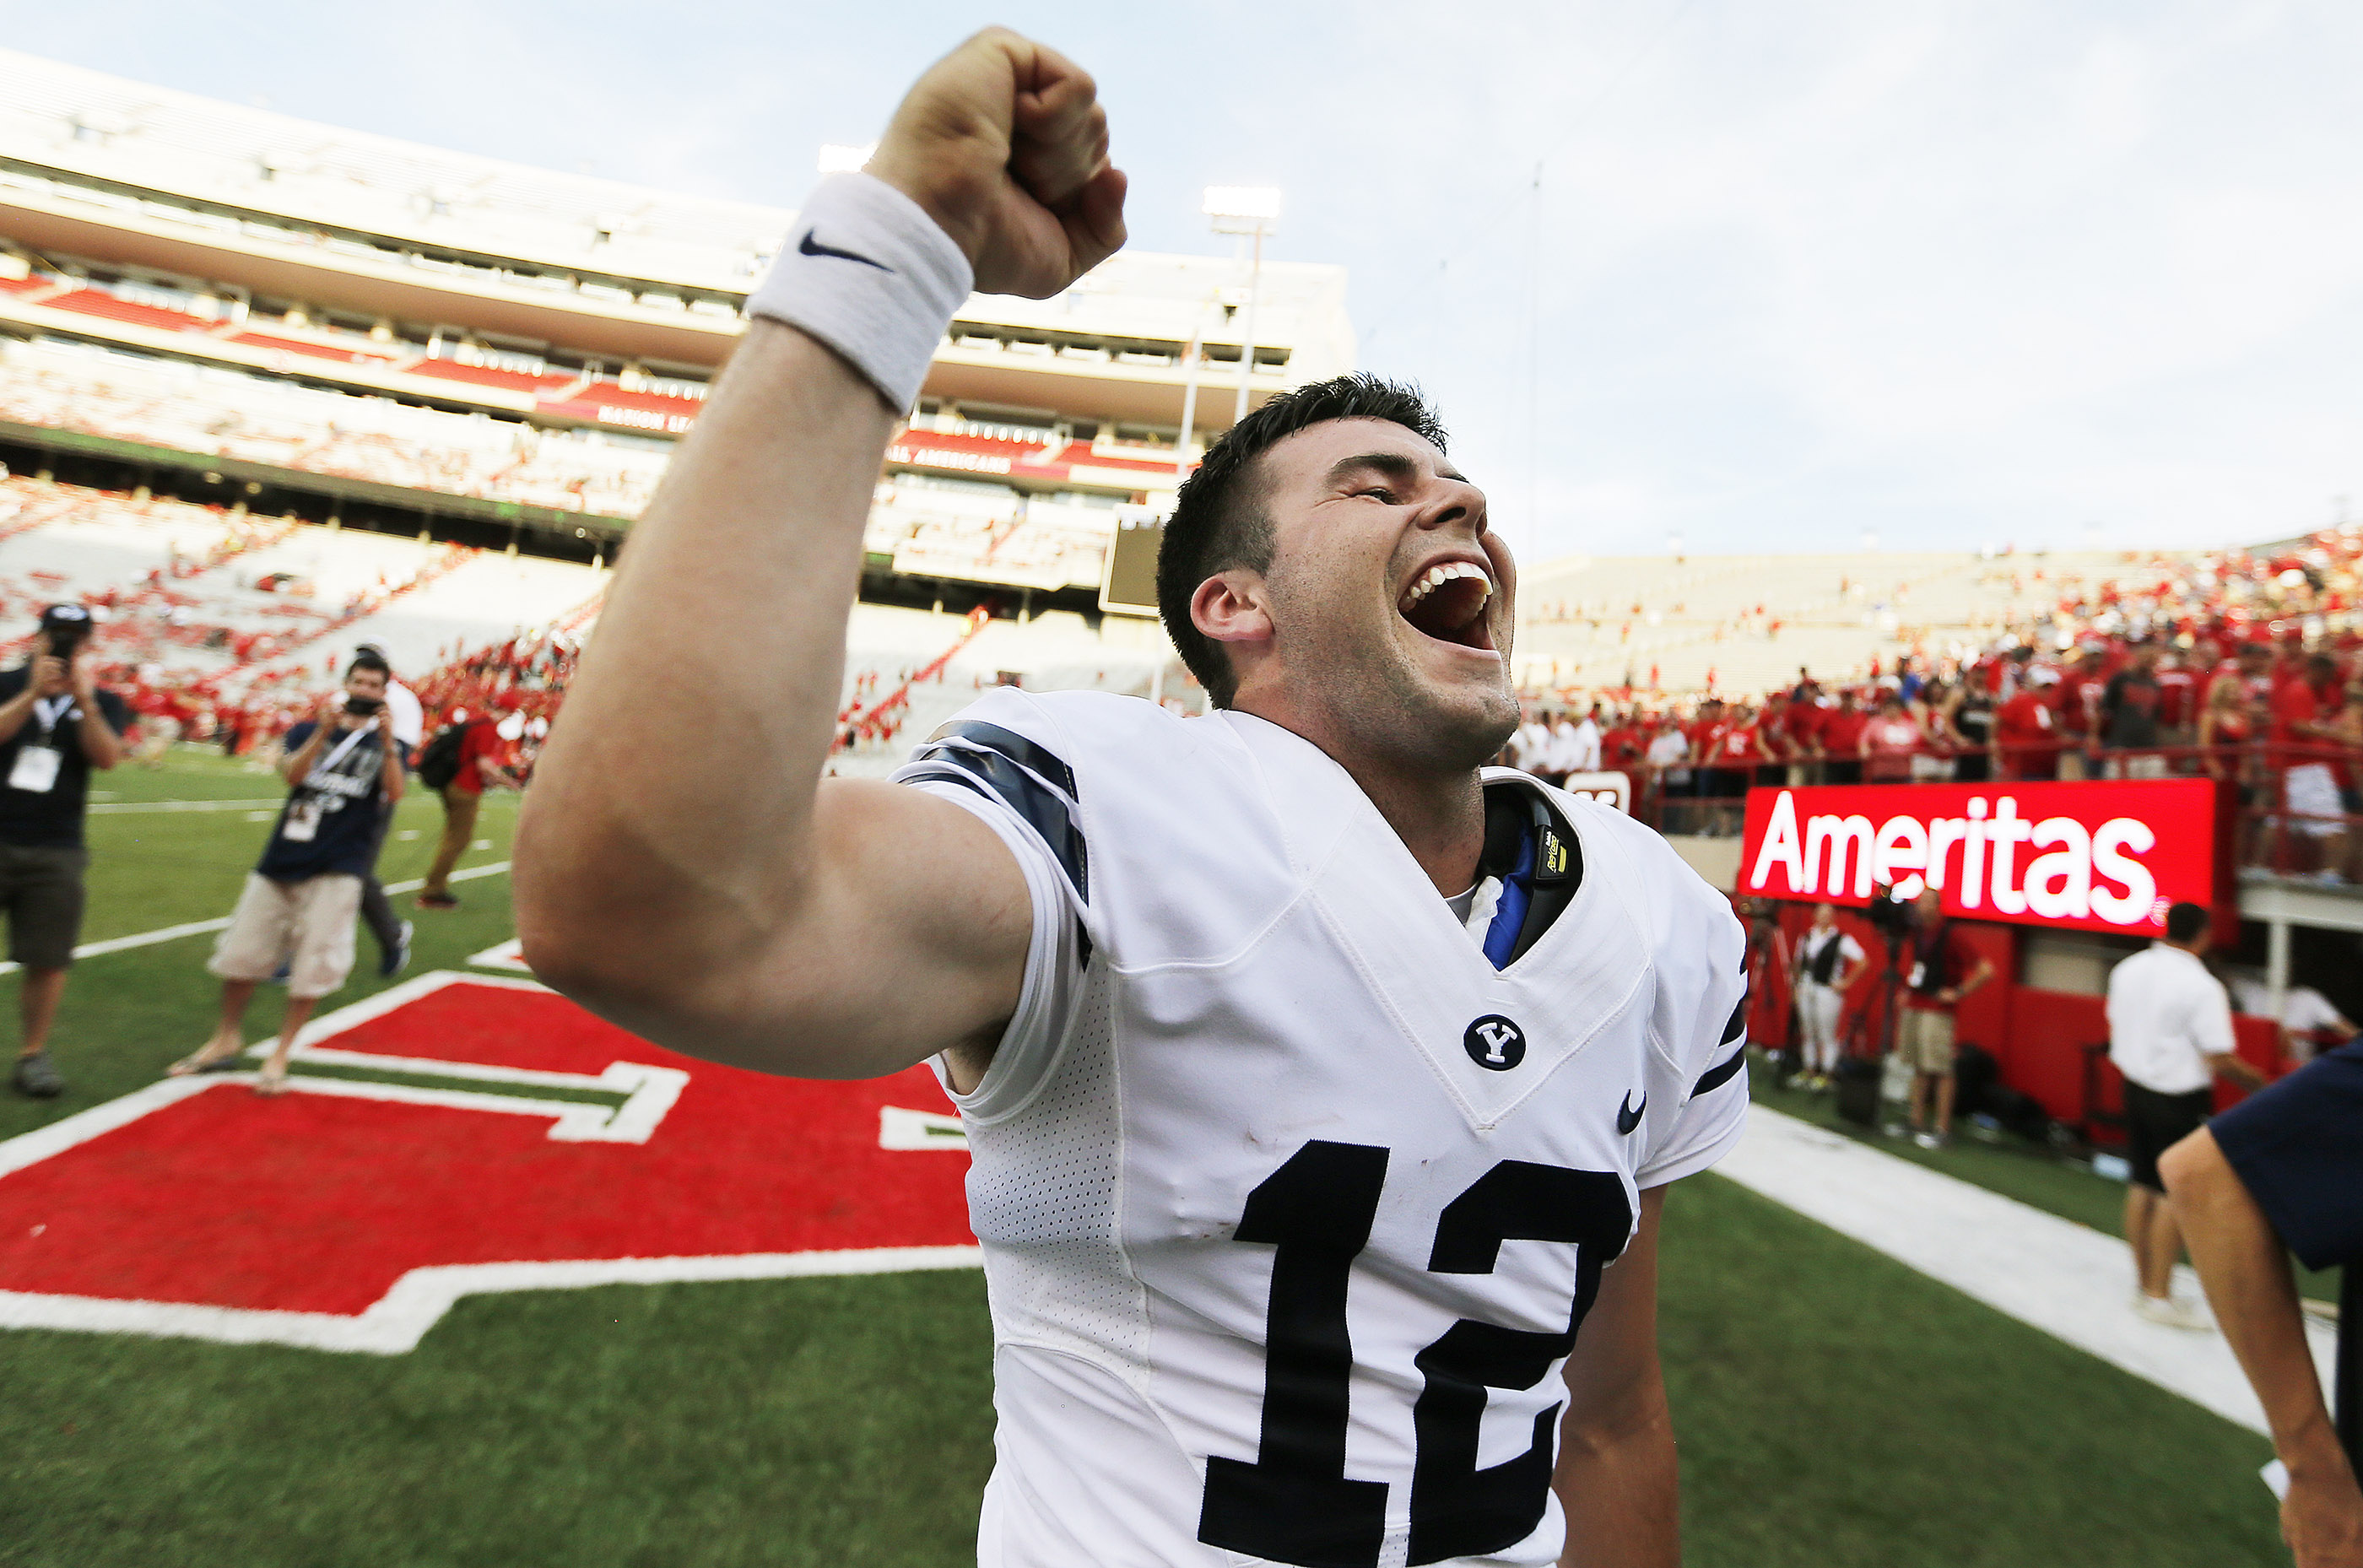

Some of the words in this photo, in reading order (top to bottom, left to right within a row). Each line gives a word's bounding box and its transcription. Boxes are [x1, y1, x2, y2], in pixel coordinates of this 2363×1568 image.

[913, 448, 1012, 475] AMERICANS
[1749, 790, 2157, 925] Ameritas
[1475, 1022, 1518, 1063] Y
[1198, 1138, 1633, 1568] 12
